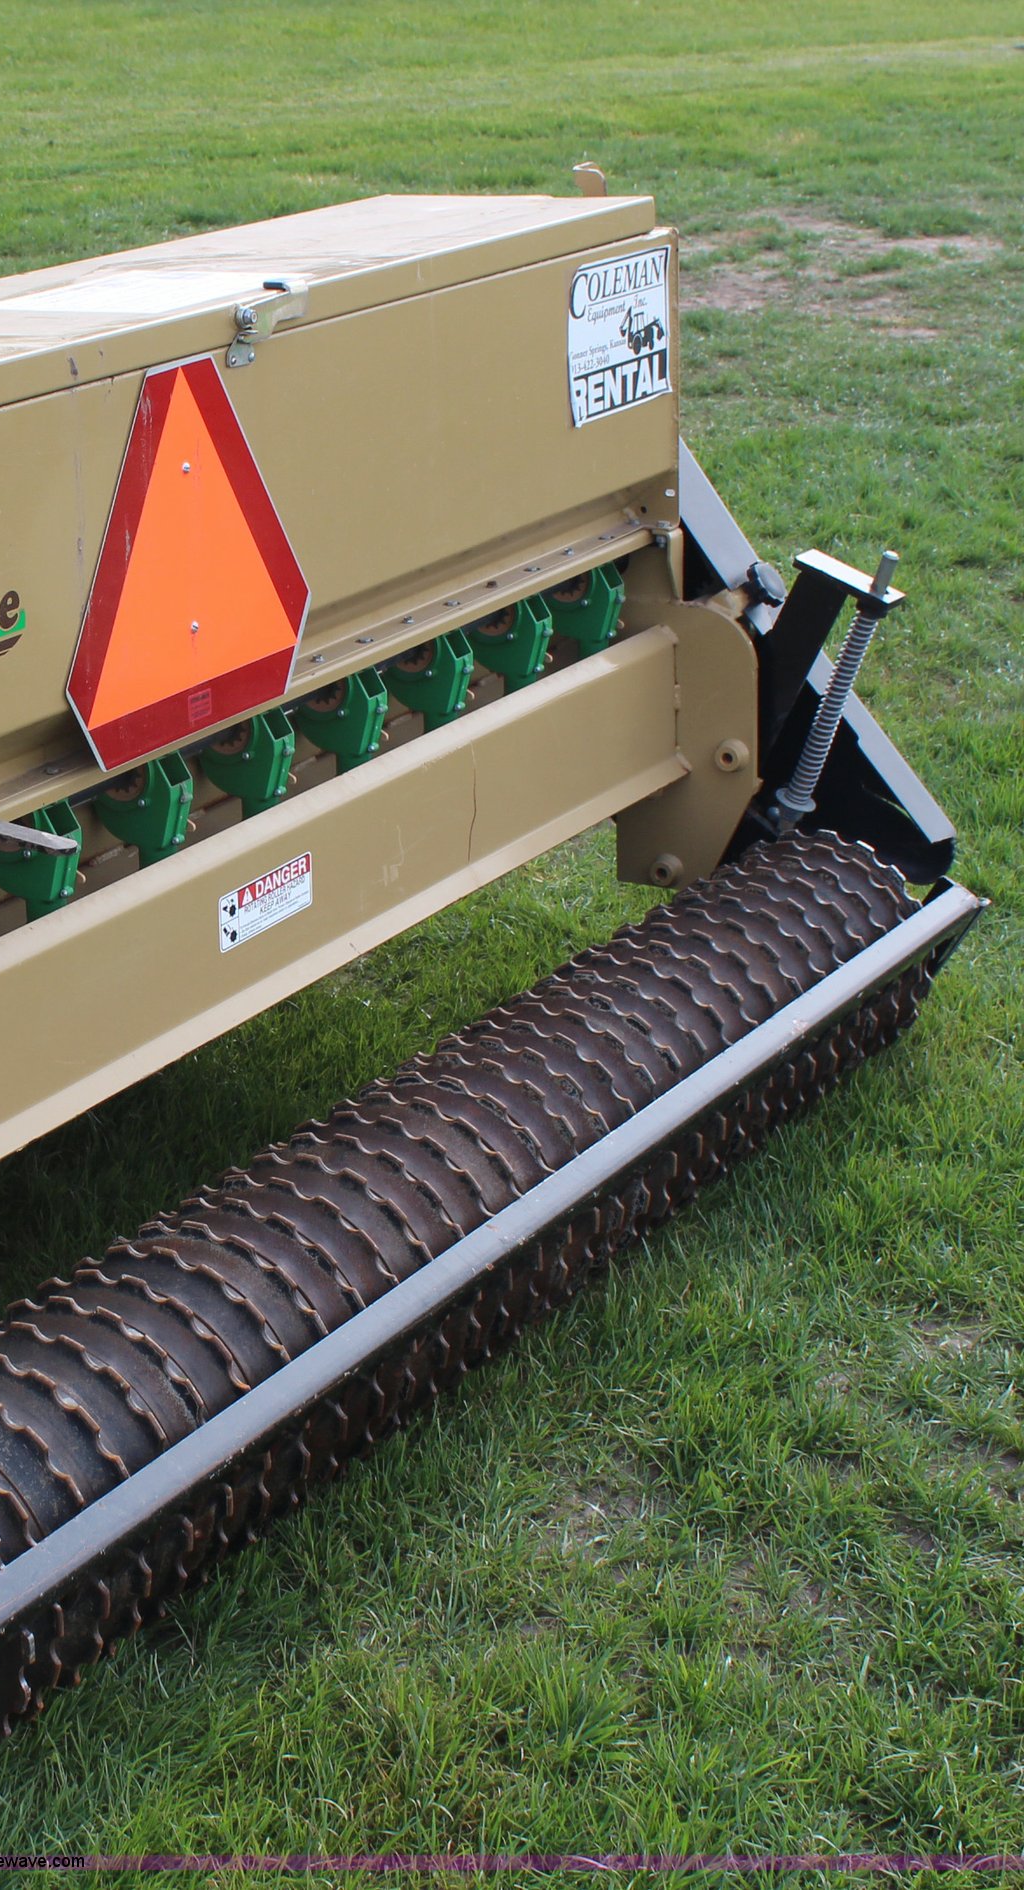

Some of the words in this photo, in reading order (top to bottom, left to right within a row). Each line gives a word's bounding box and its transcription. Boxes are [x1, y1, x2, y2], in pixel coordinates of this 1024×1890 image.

[570, 254, 664, 320] COLEMAN
[587, 302, 626, 325] Equipment
[574, 353, 667, 421] RENTAL
[255, 857, 307, 899] DANGER
[244, 895, 268, 913] ROTATING
[259, 900, 274, 914] KEEP
[275, 890, 292, 907] AWAY
